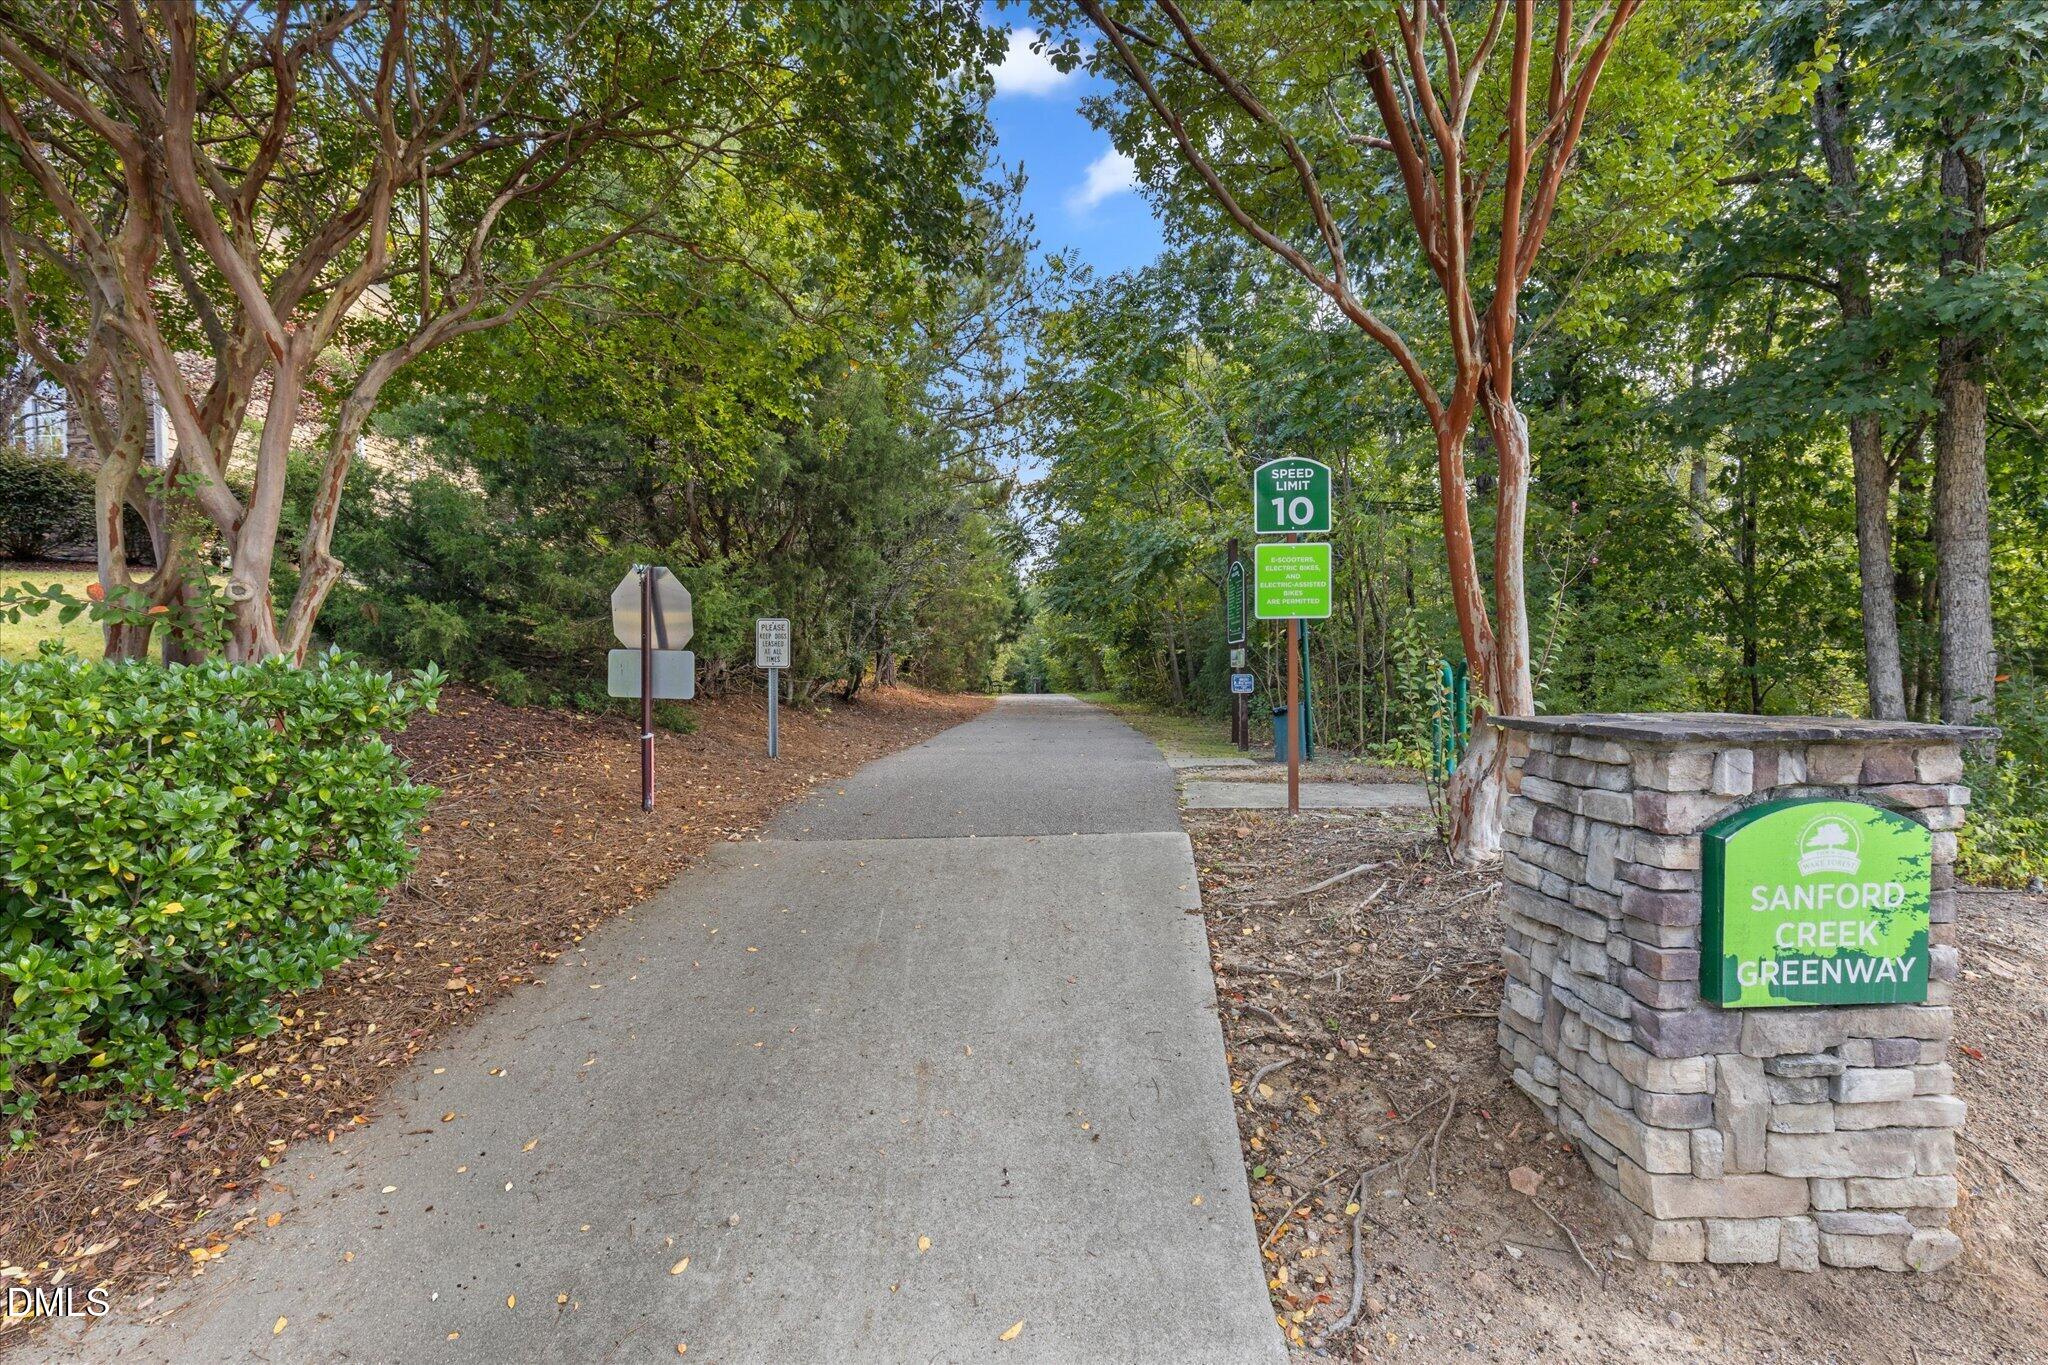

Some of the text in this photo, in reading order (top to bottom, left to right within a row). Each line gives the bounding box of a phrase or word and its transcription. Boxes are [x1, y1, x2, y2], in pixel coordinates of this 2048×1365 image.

[1271, 468, 1315, 479] SPEED
[1275, 480, 1311, 491] LIMIT
[1271, 496, 1315, 526] 10
[1751, 882, 1905, 912] SANFORD
[1776, 920, 1880, 948] CREEK
[1737, 956, 1917, 987] GREENWAY
